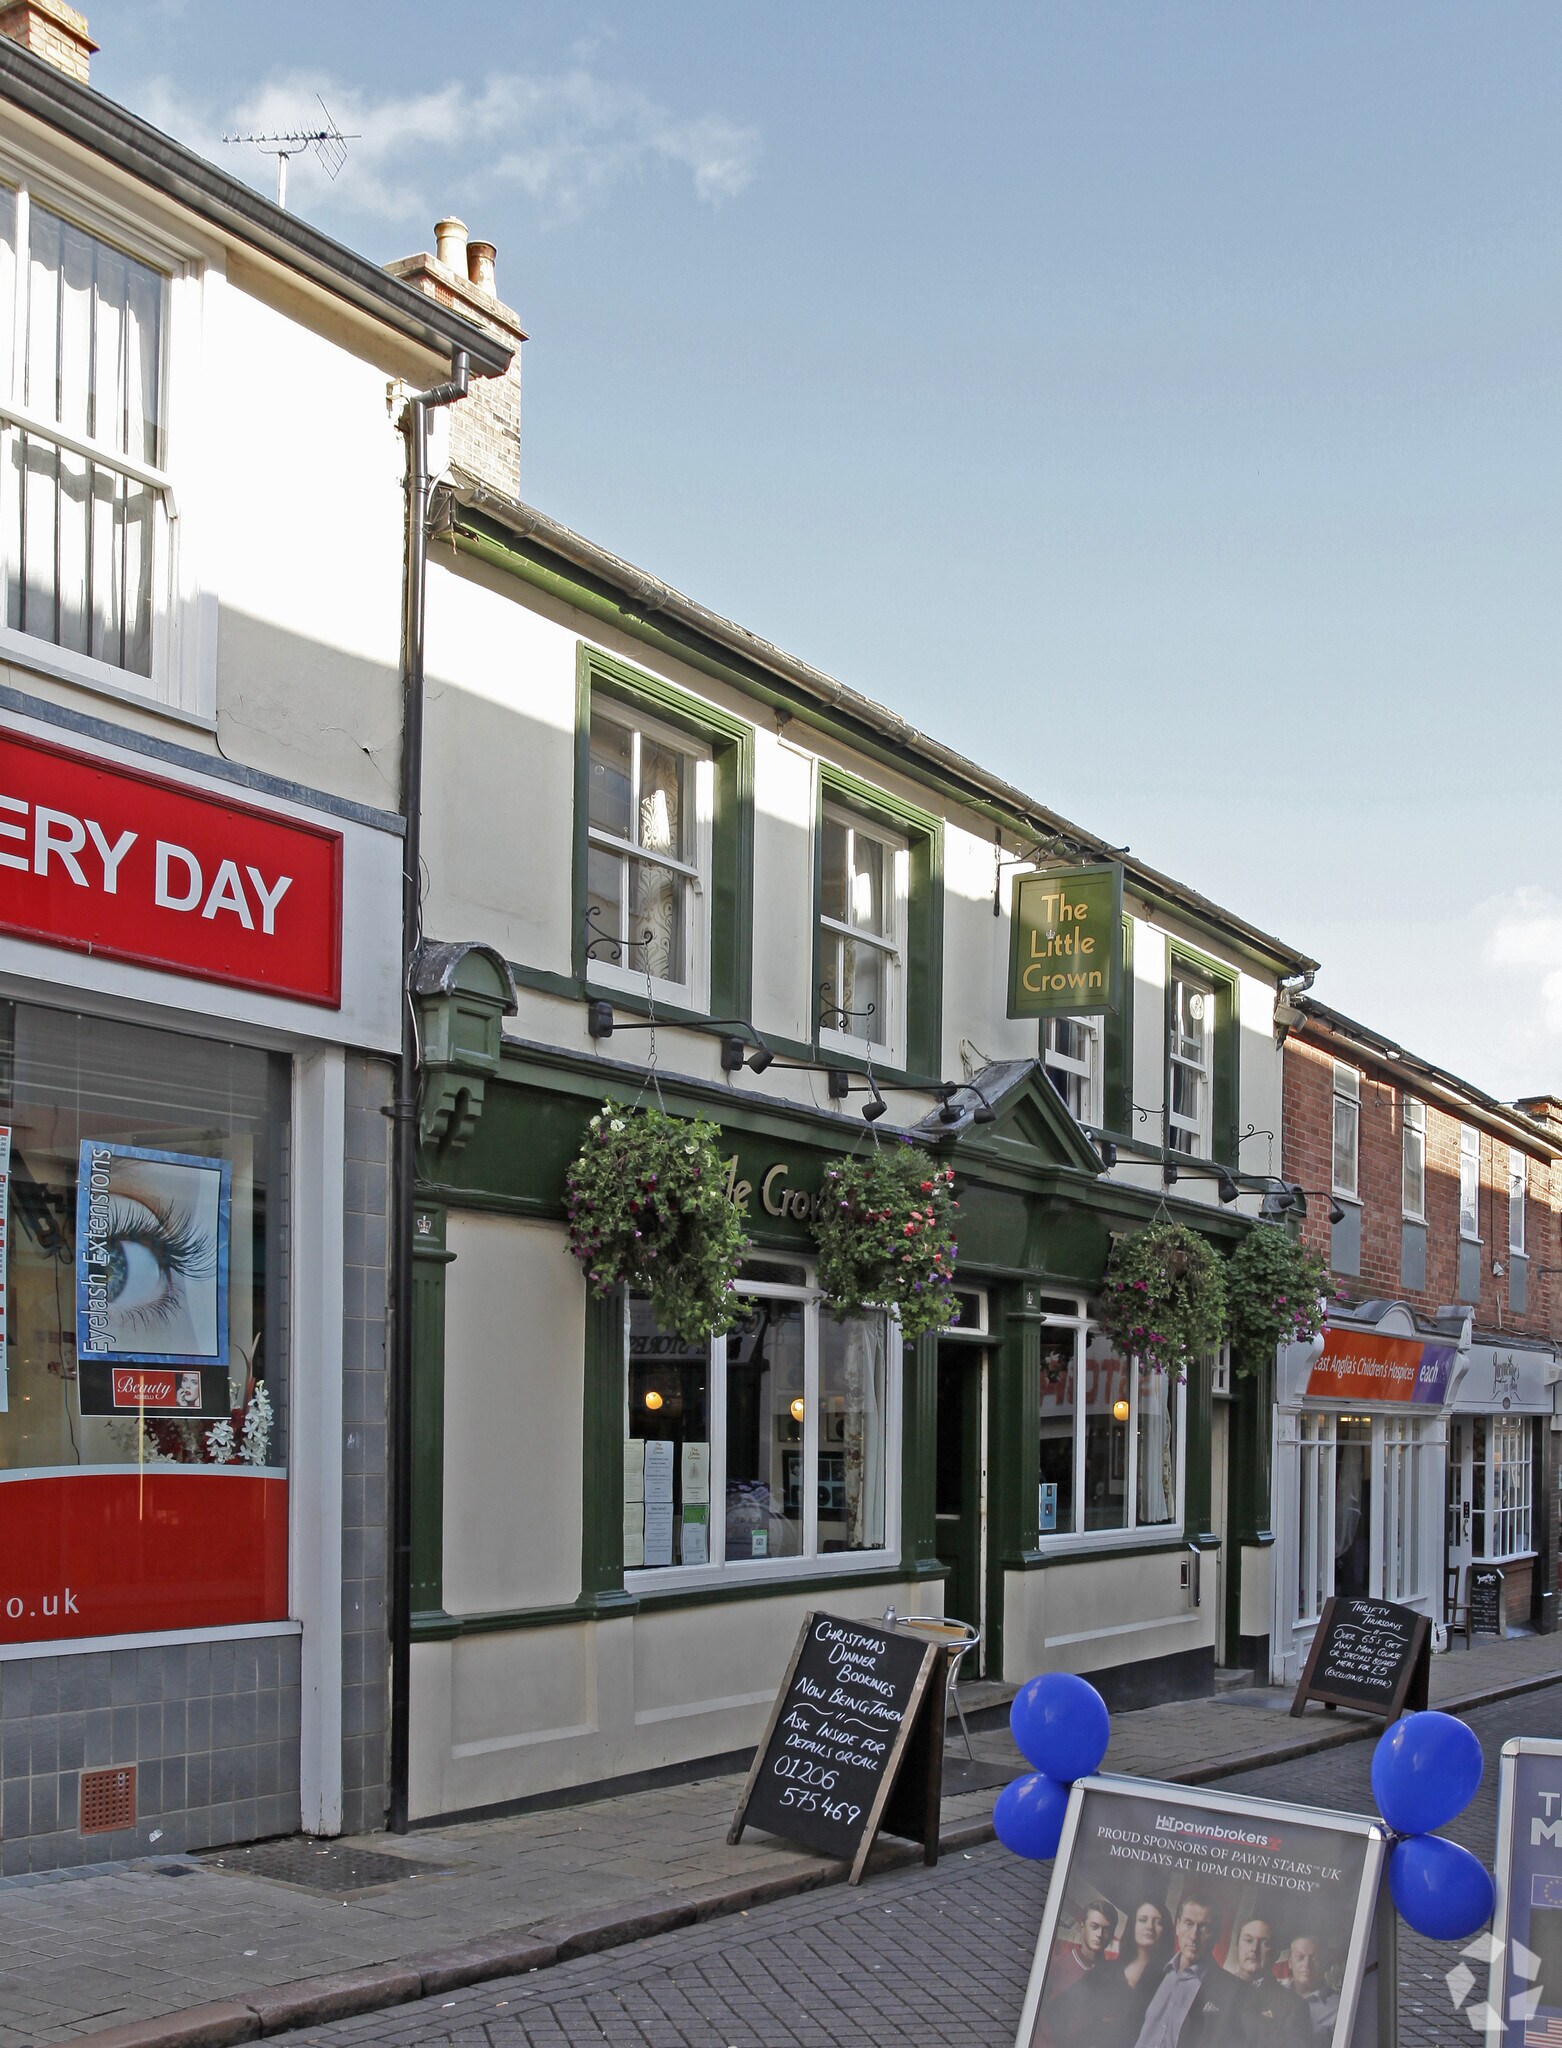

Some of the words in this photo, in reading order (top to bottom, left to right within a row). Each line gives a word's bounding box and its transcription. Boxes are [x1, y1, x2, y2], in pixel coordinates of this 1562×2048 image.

[154, 839, 293, 936] DAY
[1041, 893, 1089, 923] The
[1030, 925, 1096, 959] Little
[1022, 963, 1103, 993] Crown
[82, 1148, 113, 1267] Extensions
[81, 1274, 116, 1354] Eyelash
[1330, 1355, 1357, 1379] Anglia's
[1357, 1358, 1388, 1378] Children's
[1389, 1362, 1415, 1384] Hospices
[1419, 1360, 1439, 1383] each
[117, 1375, 172, 1400] Beauty
[0, 1588, 80, 1618] o.uk
[1349, 1600, 1390, 1616] THRIFTY
[815, 1621, 886, 1654] CHRISTMAS
[1362, 1614, 1403, 1631] THURSDAYS
[1333, 1628, 1356, 1641] OVER
[1384, 1639, 1403, 1649] GET
[1334, 1641, 1352, 1651] ANY
[1355, 1644, 1376, 1654] MAIN
[1377, 1648, 1402, 1660] COURSE
[828, 1642, 876, 1670] DINNER
[1336, 1660, 1355, 1669] MEAL
[1370, 1666, 1388, 1676] £5
[1342, 1651, 1371, 1662] SPECIALS
[1372, 1658, 1397, 1667] BOARD
[836, 1664, 896, 1697] BOOKINGS
[1324, 1666, 1363, 1683] (EXCLUDING
[1364, 1676, 1393, 1689] STEAK)
[794, 1677, 824, 1699] NOW
[828, 1687, 869, 1714] BEING
[868, 1703, 903, 1722] TAKEN
[783, 1711, 810, 1731] ASK
[816, 1718, 858, 1745] INSIDE
[860, 1738, 886, 1755] FOR
[785, 1734, 831, 1760] DETAILS
[836, 1750, 850, 1763] OR
[851, 1754, 877, 1770] CALL
[773, 1755, 840, 1790] 01206
[1538, 1791, 1562, 1817] T
[1097, 1826, 1140, 1843] PROUD
[1143, 1835, 1207, 1856] SPONSORS
[1210, 1847, 1229, 1860] OF
[1231, 1851, 1270, 1867] PAWN
[1320, 1867, 1342, 1881] UK
[1110, 1845, 1172, 1866] MONDAYS
[1174, 1859, 1192, 1870] AT
[1196, 1861, 1228, 1877] 10PM
[1231, 1867, 1252, 1881] ON
